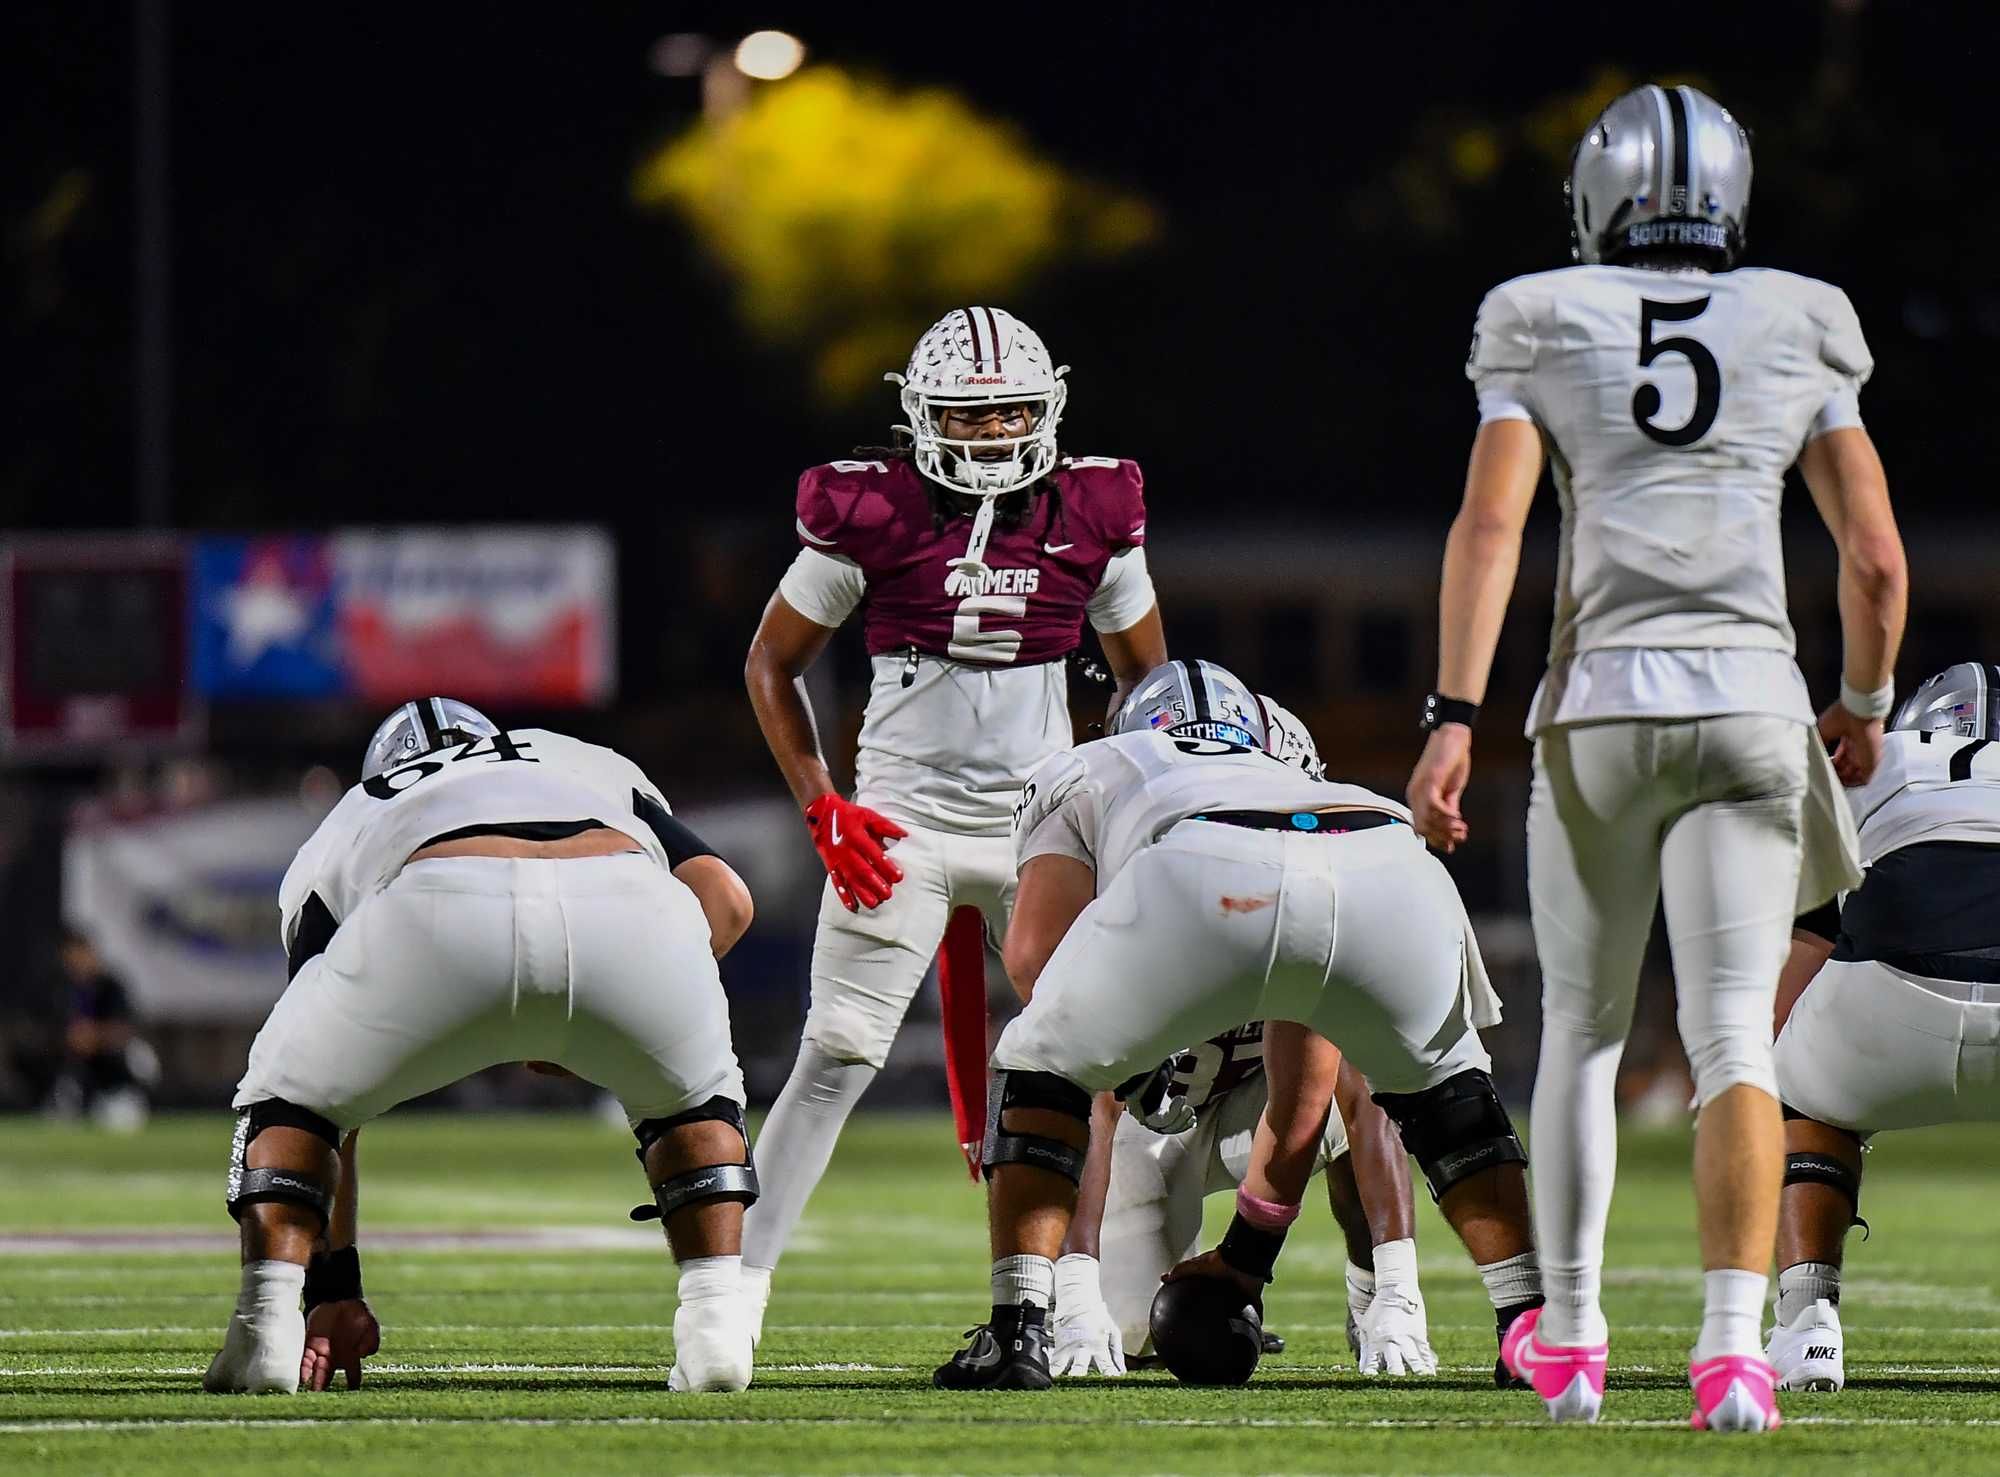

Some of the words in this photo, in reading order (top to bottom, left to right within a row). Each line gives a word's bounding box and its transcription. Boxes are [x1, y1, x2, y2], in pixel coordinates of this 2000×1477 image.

[1628, 222, 1730, 249] SOUTHSIDE
[1632, 296, 1722, 447] 5
[943, 568, 1040, 597] AMERS
[1172, 700, 1185, 722] 5
[1219, 700, 1231, 720] 5
[404, 729, 417, 750] 6
[1804, 1345, 1838, 1360] NIKE
